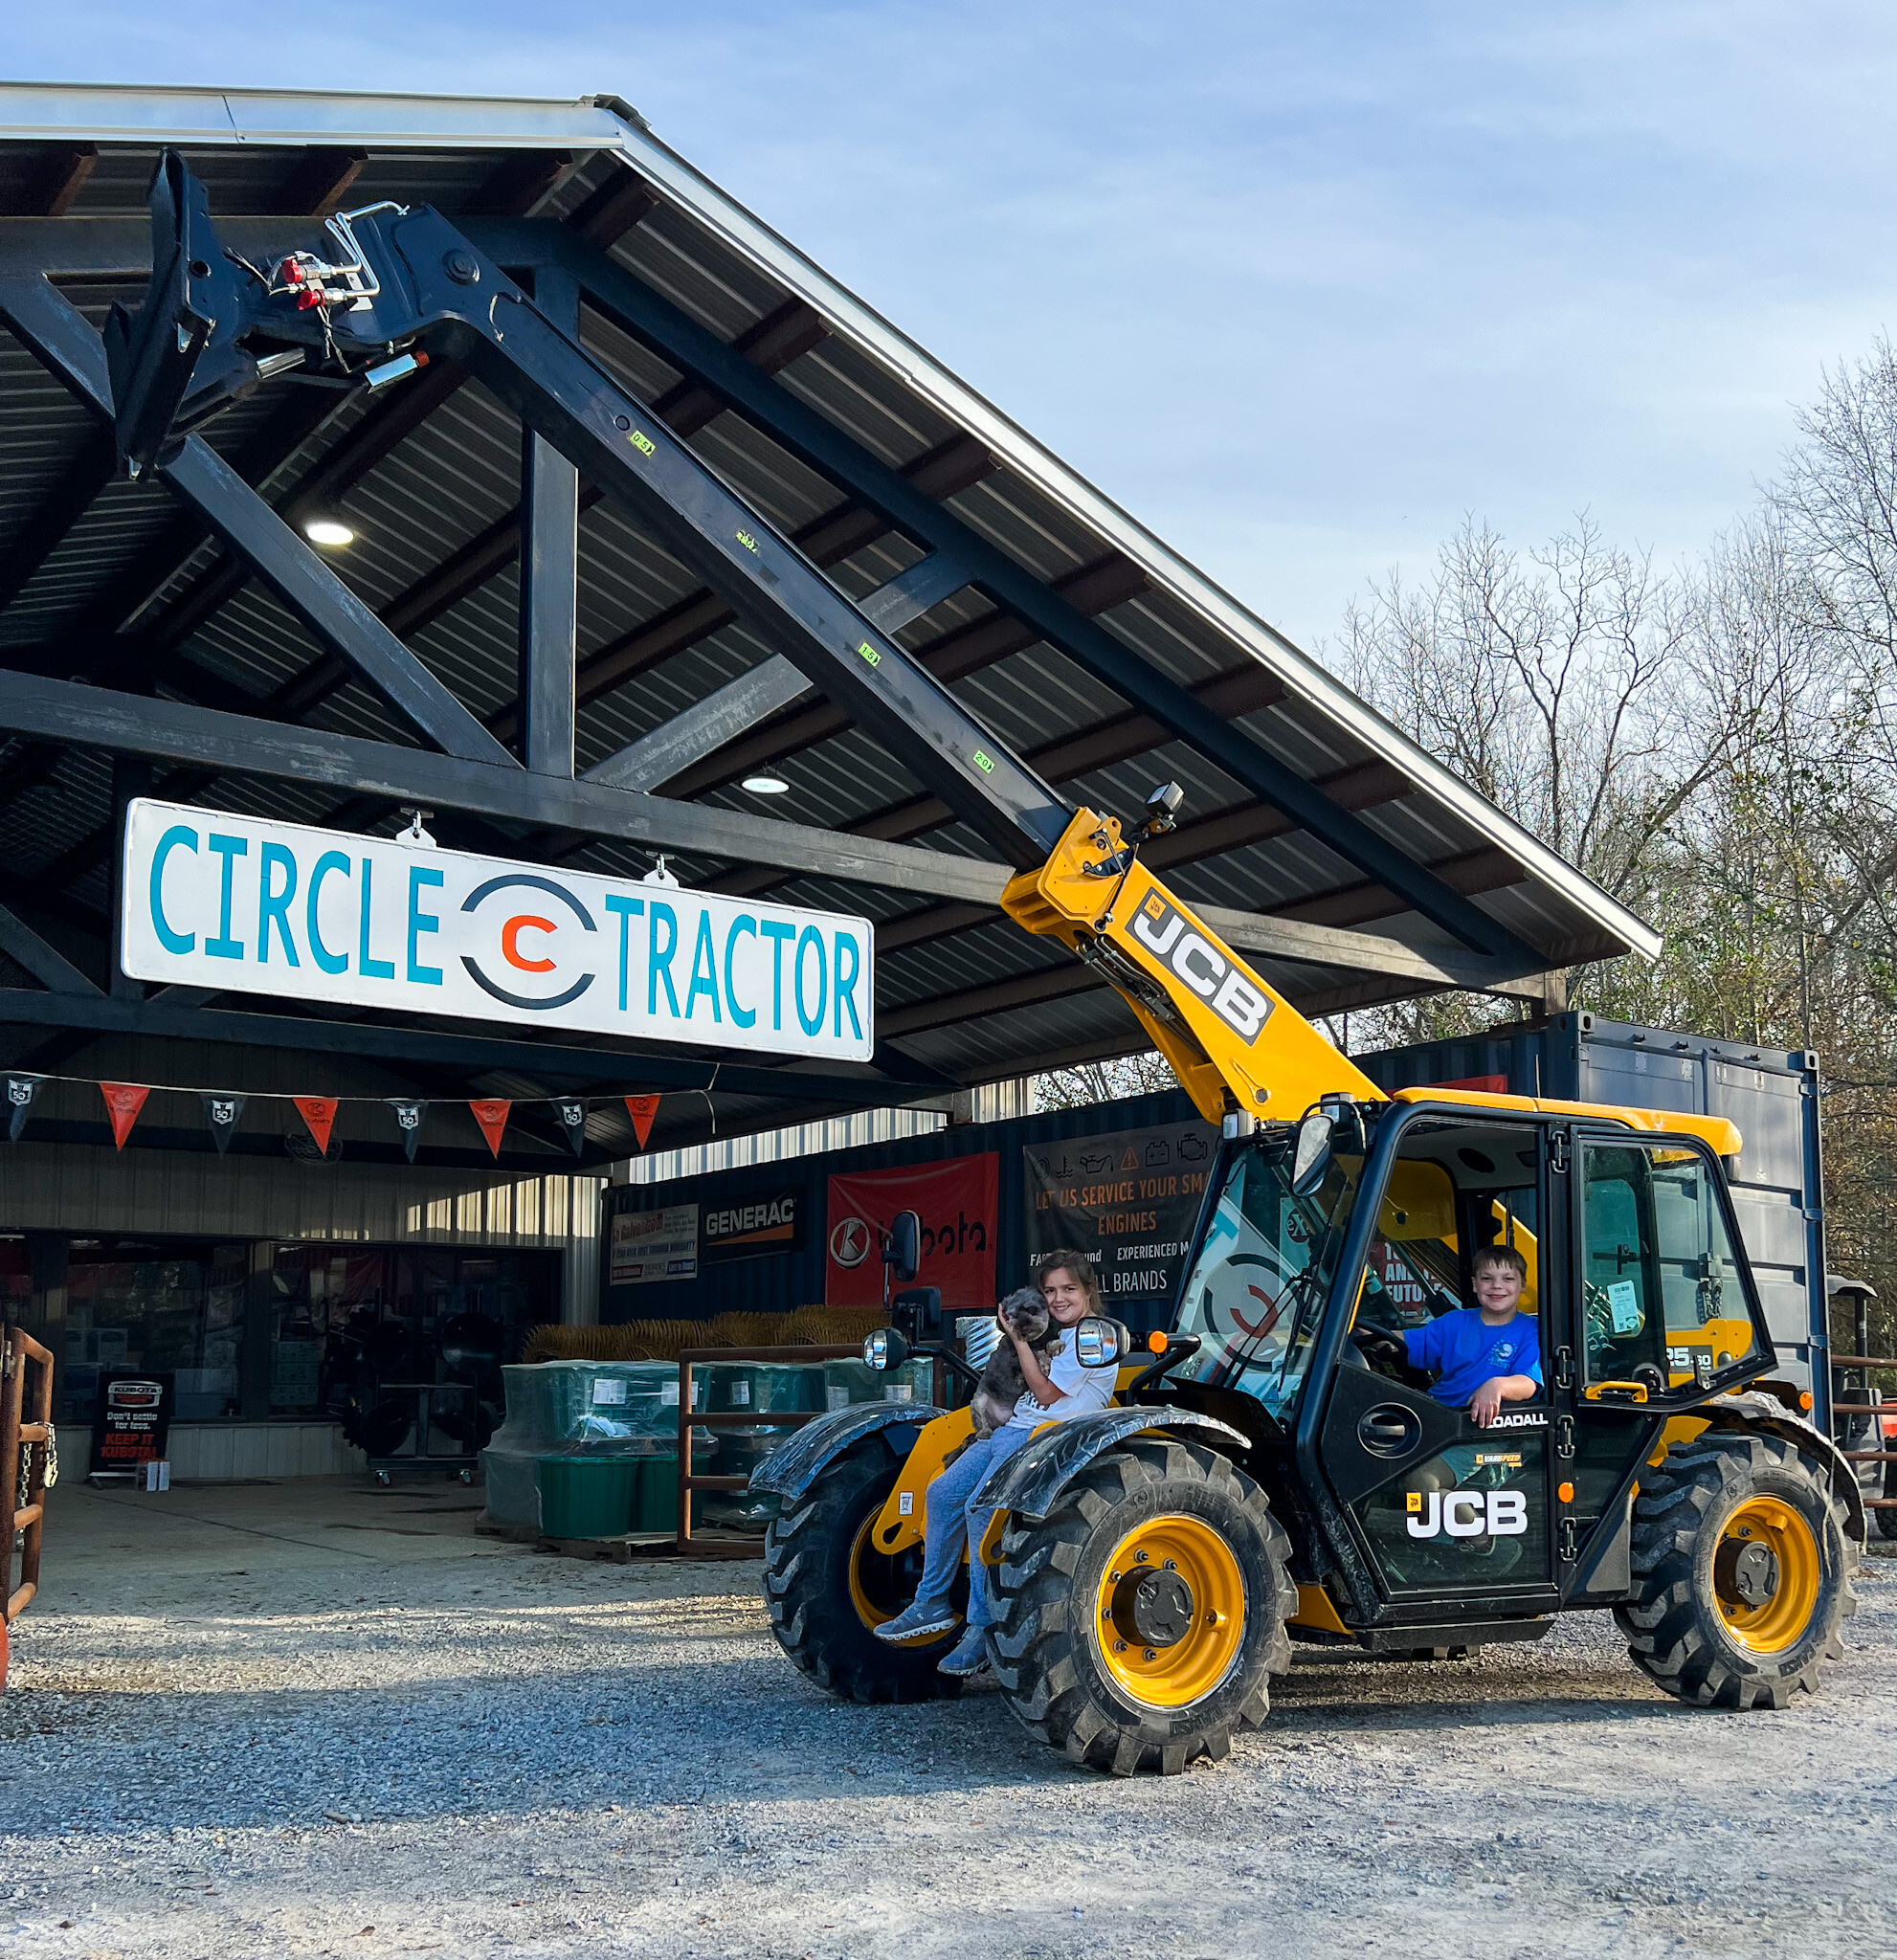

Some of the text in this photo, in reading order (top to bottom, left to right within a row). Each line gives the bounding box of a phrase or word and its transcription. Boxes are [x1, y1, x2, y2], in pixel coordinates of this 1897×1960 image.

[149, 825, 444, 986] CIRCLE
[605, 895, 863, 1040] TRACTOR
[1133, 914, 1267, 1037] JCB
[1036, 1191, 1056, 1210] LET
[1059, 1188, 1078, 1208] US
[1082, 1181, 1134, 1207] SERVICE
[1139, 1175, 1176, 1199] YOUR
[706, 1198, 794, 1236] GENERAC
[1098, 1211, 1157, 1236] ENGINES
[1117, 1242, 1177, 1262] EXPERIENCED
[1113, 1269, 1168, 1294] BRANDS
[105, 1434, 139, 1445] KEEP
[1406, 1490, 1529, 1539] JCB
